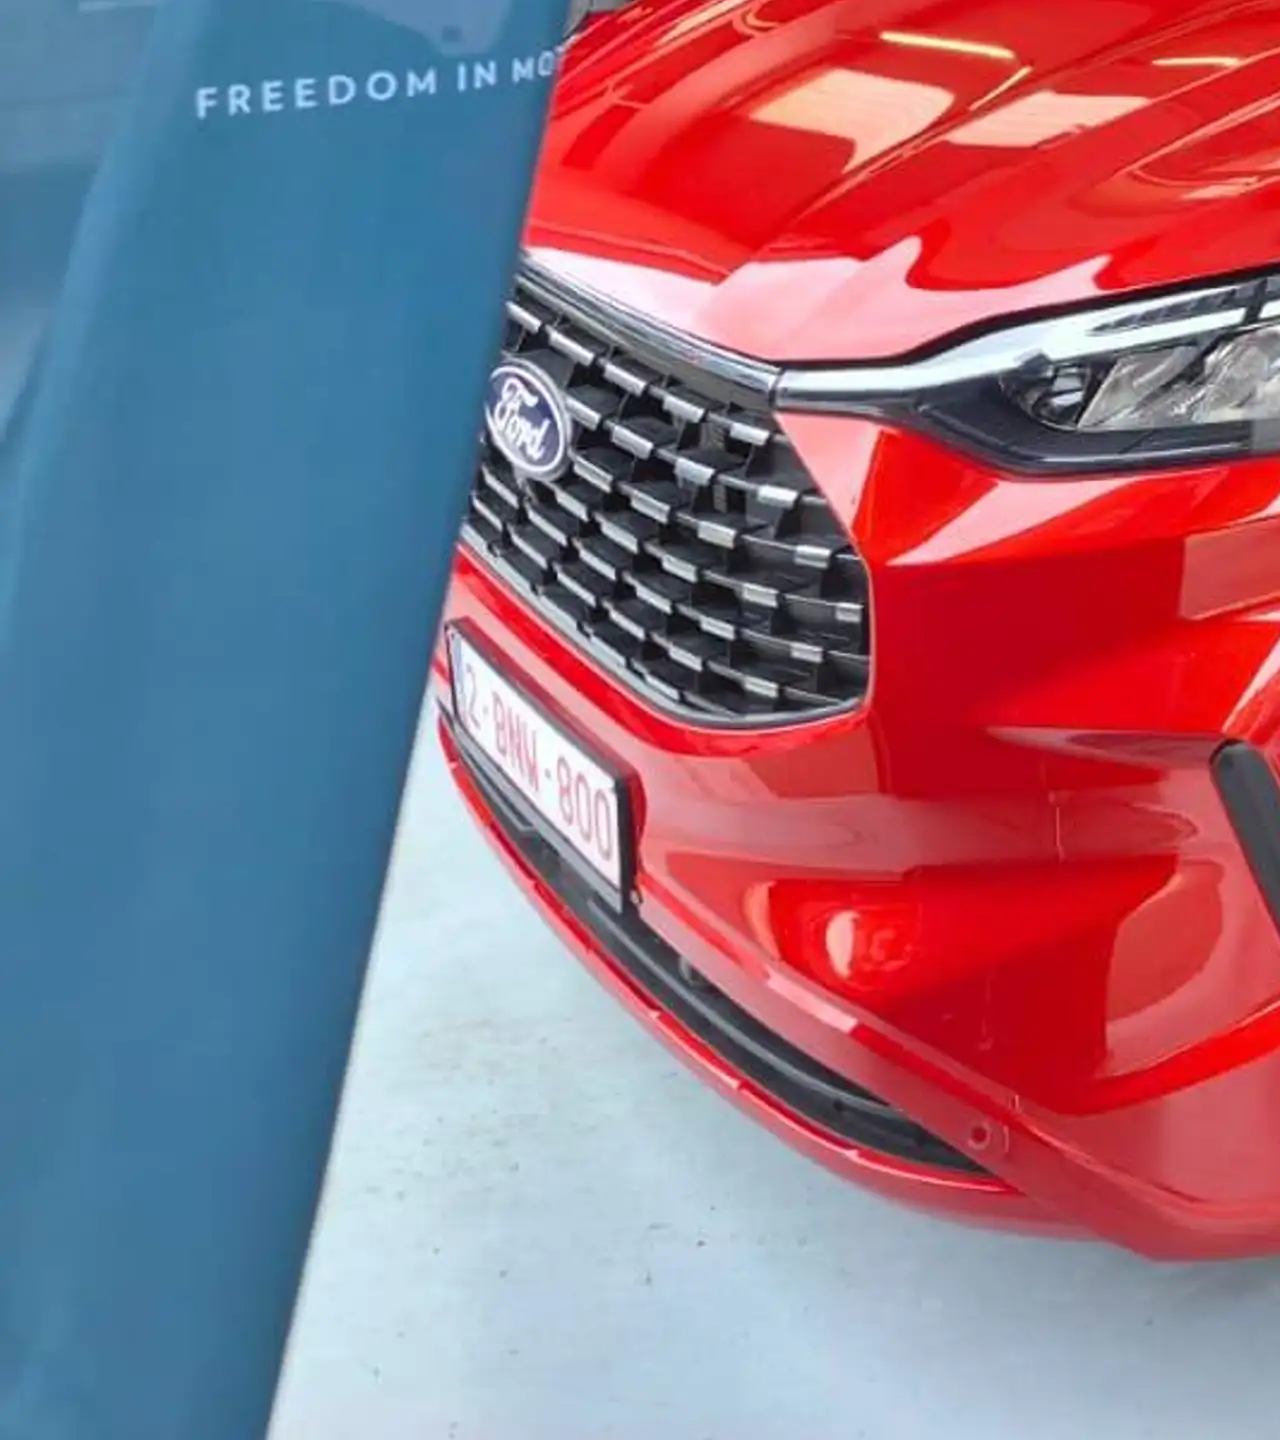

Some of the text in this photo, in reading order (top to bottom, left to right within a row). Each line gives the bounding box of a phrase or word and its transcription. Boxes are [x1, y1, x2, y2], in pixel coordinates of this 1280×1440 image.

[195, 68, 438, 118] FREEDOM
[456, 61, 498, 92] IN
[494, 377, 551, 461] Ford
